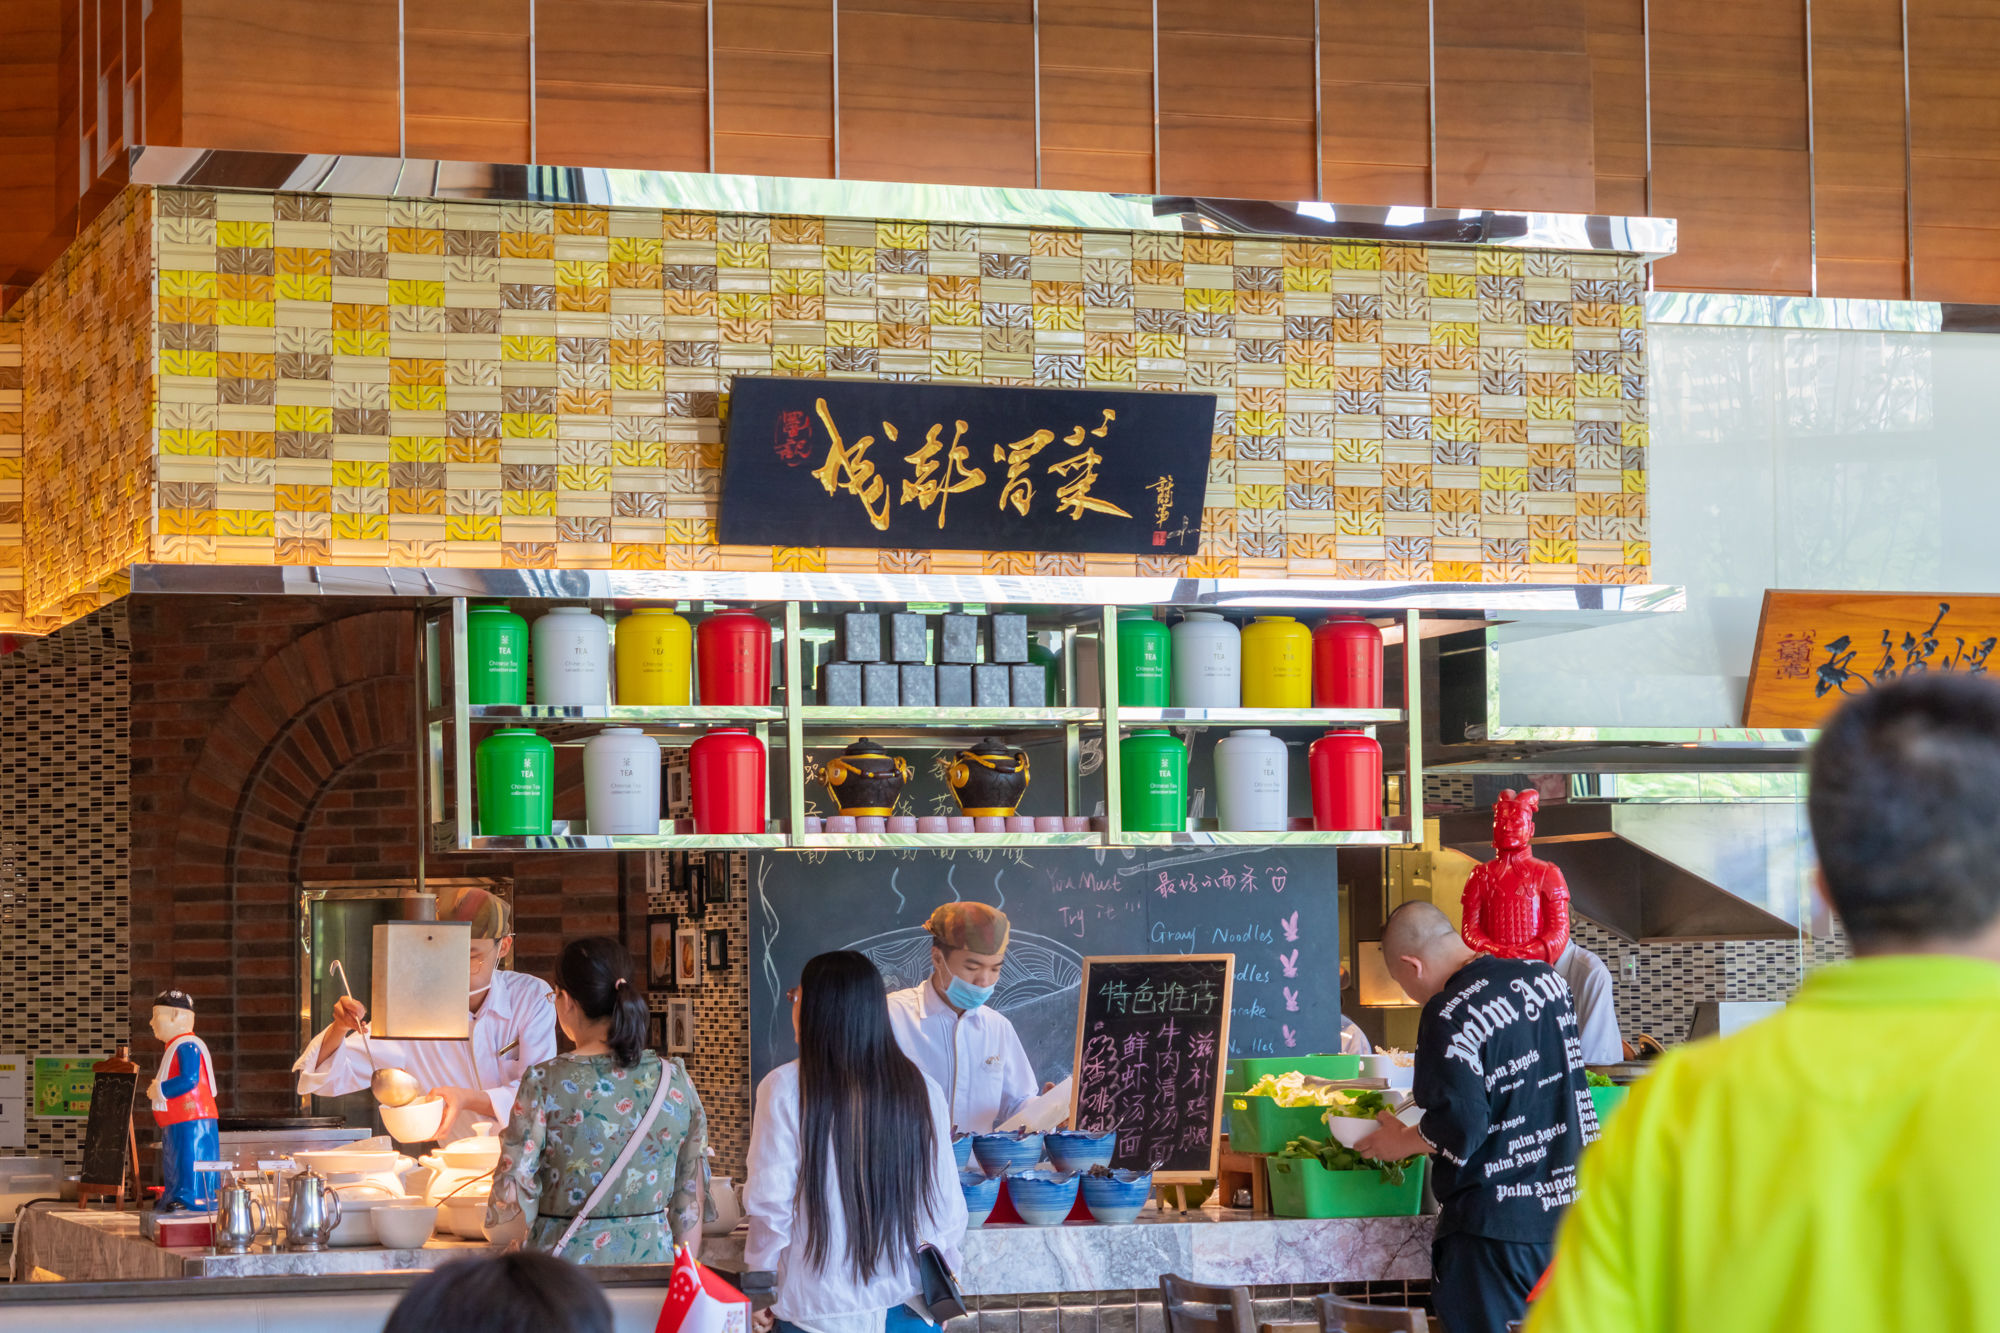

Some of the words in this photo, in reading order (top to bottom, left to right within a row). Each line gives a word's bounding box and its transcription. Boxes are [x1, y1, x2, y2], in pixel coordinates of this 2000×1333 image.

[575, 647, 587, 655] TEA
[521, 770, 534, 778] TEA
[620, 769, 633, 777] TEA
[1079, 871, 1122, 892] Must
[1058, 906, 1084, 938] Try
[1211, 923, 1273, 944] Noodles
[1099, 977, 1219, 1014] 特色推荐
[1439, 998, 1462, 1020] Palm
[1458, 978, 1489, 1000] Angels
[1444, 996, 1519, 1077] Palm
[1508, 1050, 1540, 1076] Angels
[1118, 1031, 1150, 1158] 鲜虾汤面
[1150, 1016, 1181, 1164] 牛肉清汤面
[1488, 1124, 1500, 1134] alm
[1502, 1115, 1526, 1131] Angels
[1508, 1134, 1535, 1155] Palm
[1484, 1158, 1515, 1178] Palm
[1496, 1182, 1533, 1202] Palm
[1534, 1173, 1577, 1198] Angels
[1541, 1190, 1571, 1212] Palm
